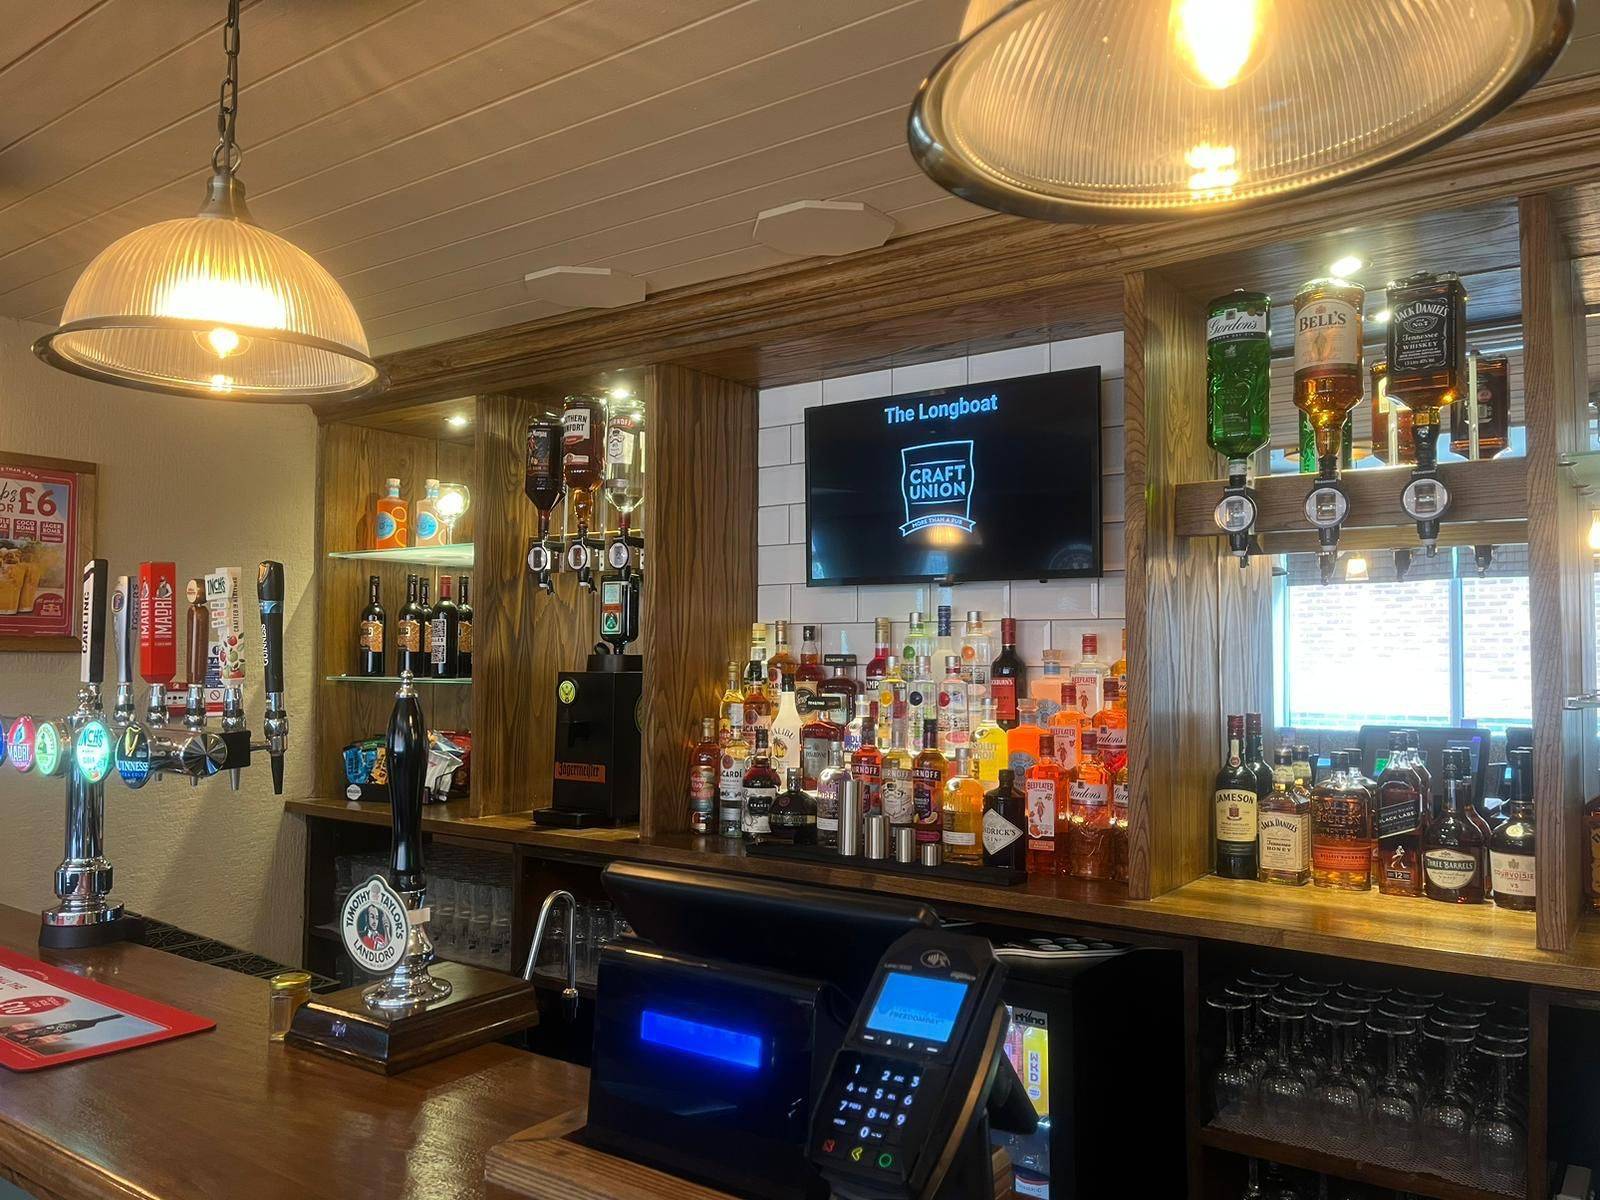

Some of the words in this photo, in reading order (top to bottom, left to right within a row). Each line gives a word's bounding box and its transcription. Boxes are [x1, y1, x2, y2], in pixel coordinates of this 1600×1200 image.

[1299, 311, 1347, 332] BELL'S
[1394, 307, 1415, 323] JACK
[1416, 302, 1449, 317] DANIEL'S
[1209, 316, 1257, 336] Gordon's
[1403, 341, 1438, 350] WHISKEY
[884, 405, 915, 424] The
[919, 394, 998, 420] Longboat
[910, 464, 966, 484] CRAFT
[910, 481, 966, 500] UNION
[19, 486, 57, 517] £6
[912, 519, 928, 528] MORE
[261, 623, 269, 666] GUINNESS
[1216, 793, 1255, 804] JAMESON
[1261, 819, 1275, 831] JACK
[1427, 858, 1443, 868] THREE
[1443, 861, 1473, 870] BARRELS
[346, 890, 371, 928] TIMOTHY
[380, 893, 403, 940] TAYLOR'S
[353, 939, 395, 963] LANDLORD
[1015, 1011, 1045, 1026] rhino
[855, 1064, 861, 1074] 1
[881, 1070, 891, 1081] 2
[911, 1076, 920, 1087] 3
[846, 1082, 854, 1092] 4
[874, 1088, 884, 1099] 5
[904, 1095, 912, 1106] 6
[839, 1100, 848, 1111] 7
[867, 1108, 877, 1119] 8
[897, 1114, 906, 1126] 9
[860, 1126, 869, 1138] 0
